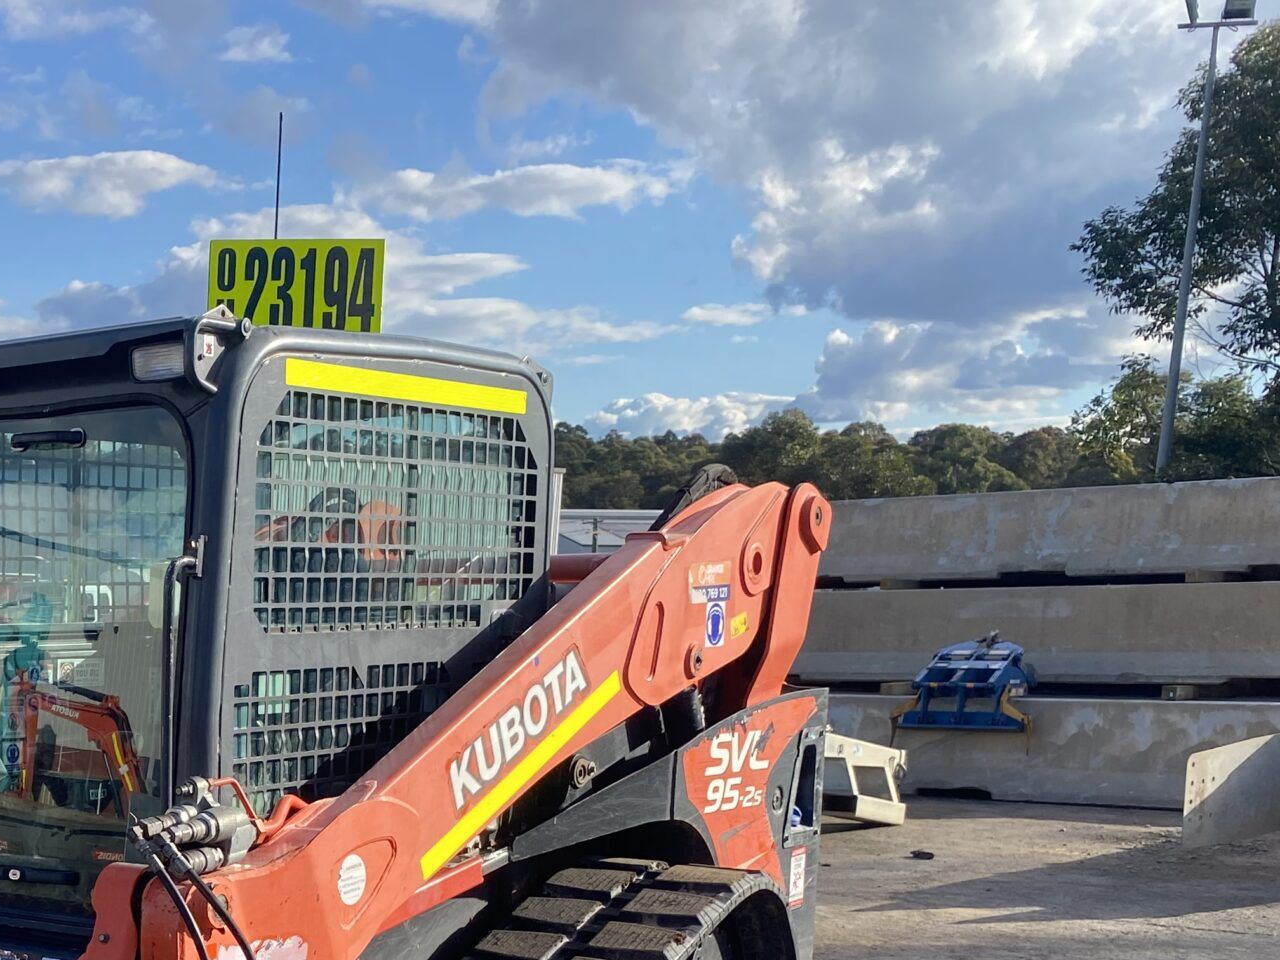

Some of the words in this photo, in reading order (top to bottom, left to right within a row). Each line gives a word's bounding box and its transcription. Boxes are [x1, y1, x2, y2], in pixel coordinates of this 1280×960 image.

[244, 246, 376, 333] 23194
[707, 588, 719, 599] 769
[449, 650, 588, 811] KUBOTA
[704, 729, 770, 777] SVL
